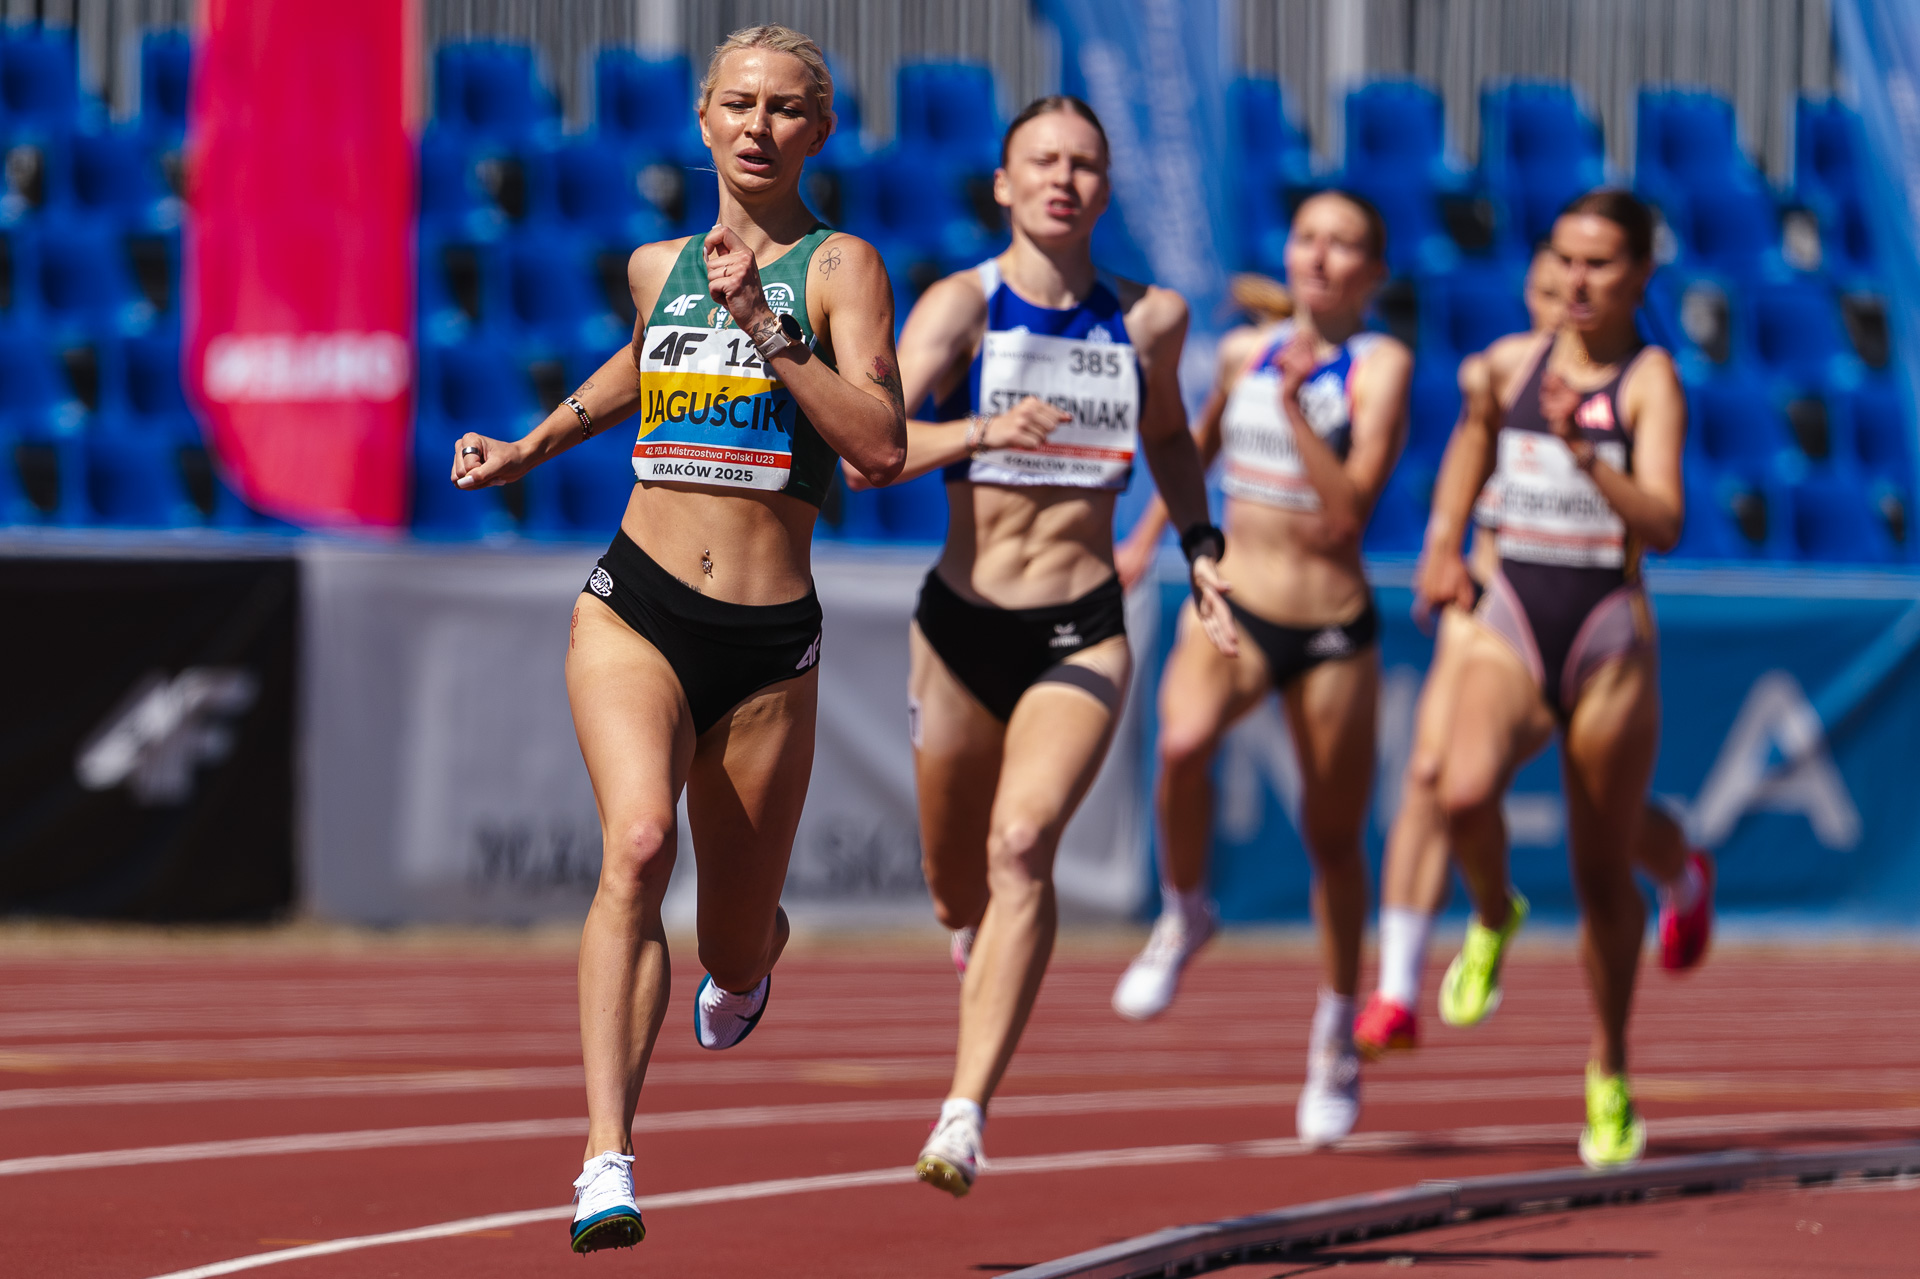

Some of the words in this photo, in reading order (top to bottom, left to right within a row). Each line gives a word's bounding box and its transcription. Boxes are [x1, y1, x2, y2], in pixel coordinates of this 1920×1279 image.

[663, 294, 705, 316] 4F
[648, 331, 709, 366] 4F
[1069, 347, 1121, 378] 385
[645, 386, 788, 433] JAGUŚCIK
[989, 387, 1129, 430] STPNIAK
[655, 446, 668, 455] PZLA
[668, 446, 723, 460] Mistrzostwa
[724, 452, 754, 463] Polski
[755, 455, 775, 465] U23
[652, 461, 712, 478] KRAKÓW
[714, 467, 754, 482] 2025
